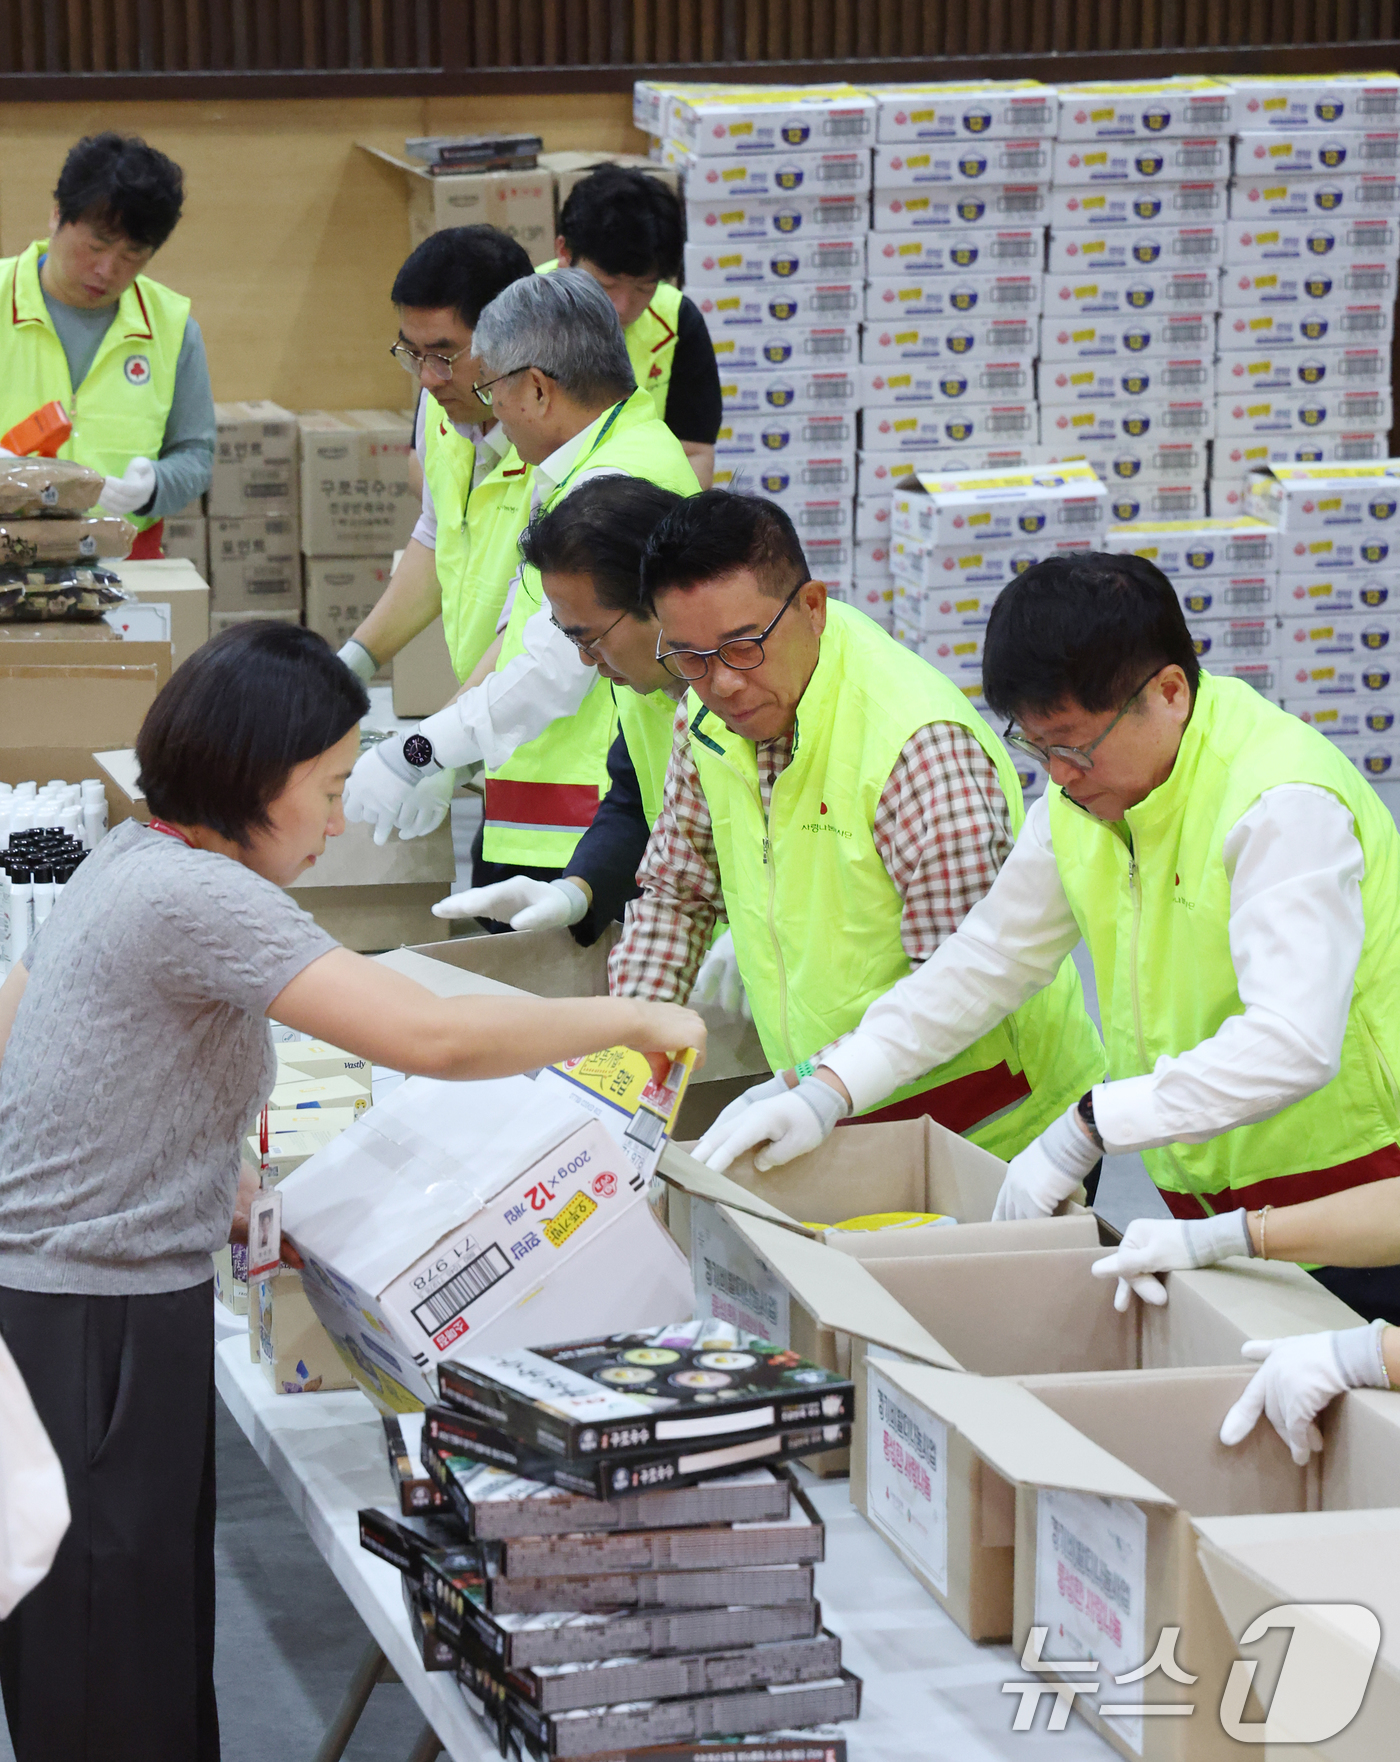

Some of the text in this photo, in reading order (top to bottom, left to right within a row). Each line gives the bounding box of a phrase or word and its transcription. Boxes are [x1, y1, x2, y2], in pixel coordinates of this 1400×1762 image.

[344, 1060, 366, 1069] Vastly
[551, 1200, 587, 1241] 오뚜기밥
[510, 1231, 541, 1260] 흰밥
[413, 1260, 448, 1290] 978
[435, 1320, 465, 1348] 소매점
